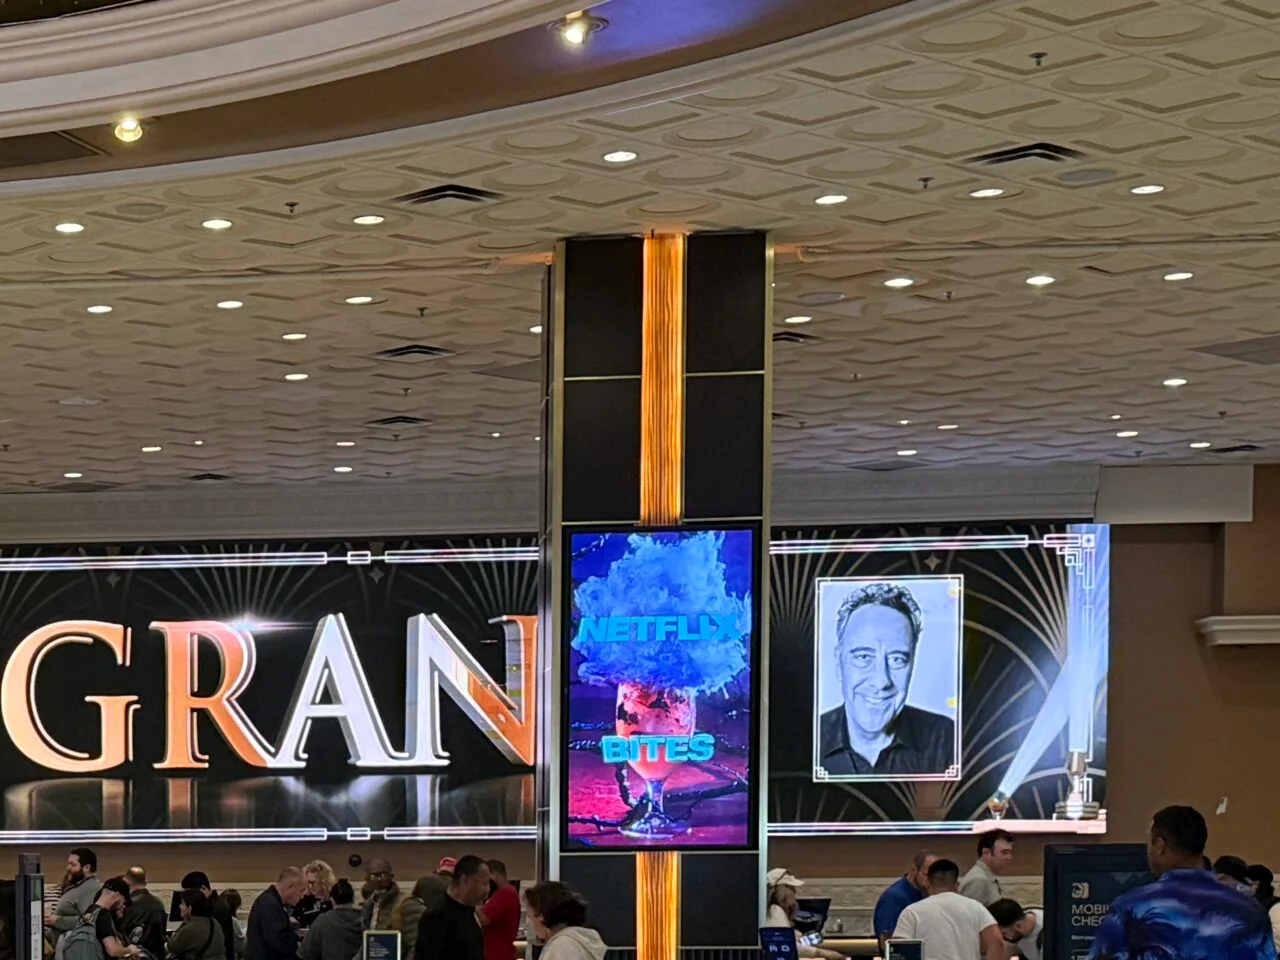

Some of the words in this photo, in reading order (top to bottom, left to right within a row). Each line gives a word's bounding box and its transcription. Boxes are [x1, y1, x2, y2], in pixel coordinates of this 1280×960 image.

[579, 614, 739, 642] NETFLIX
[1, 613, 538, 773] GRAN
[601, 733, 715, 763] BITES
[1072, 904, 1109, 914] MOBI
